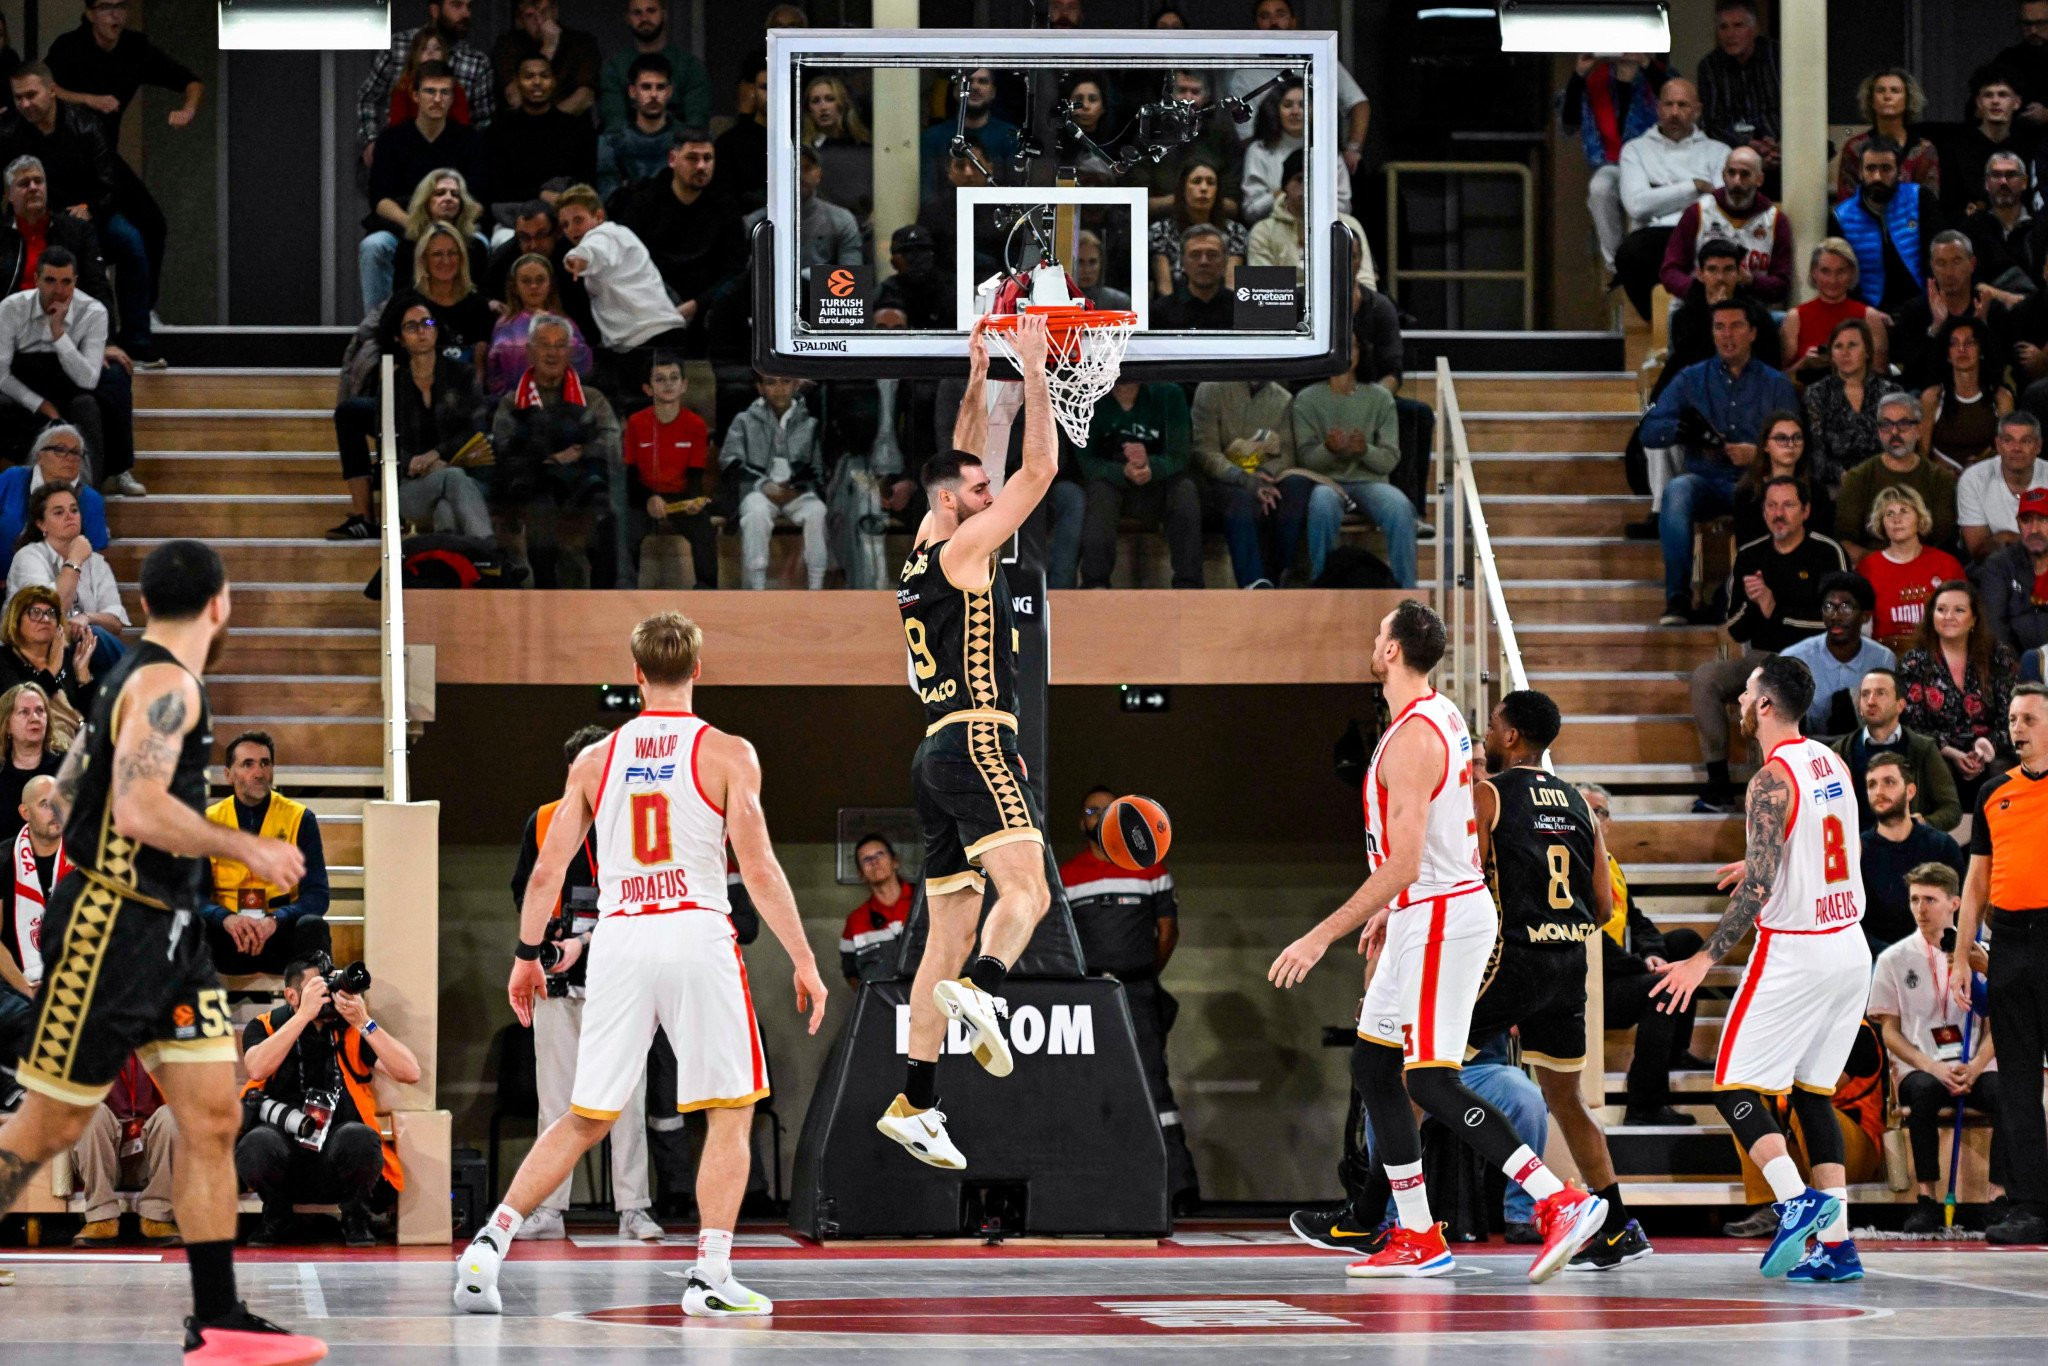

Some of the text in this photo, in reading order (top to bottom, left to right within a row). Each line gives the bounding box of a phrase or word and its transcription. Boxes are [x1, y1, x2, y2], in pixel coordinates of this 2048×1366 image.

[820, 299, 863, 307] TURKISH
[820, 308, 863, 316] AIRLINES
[818, 317, 864, 326] EuroLeague
[793, 341, 847, 352] SPALDING
[1529, 787, 1569, 807] LOYD
[630, 791, 673, 867] 0
[1822, 814, 1849, 884] 8
[1547, 845, 1574, 909] 8
